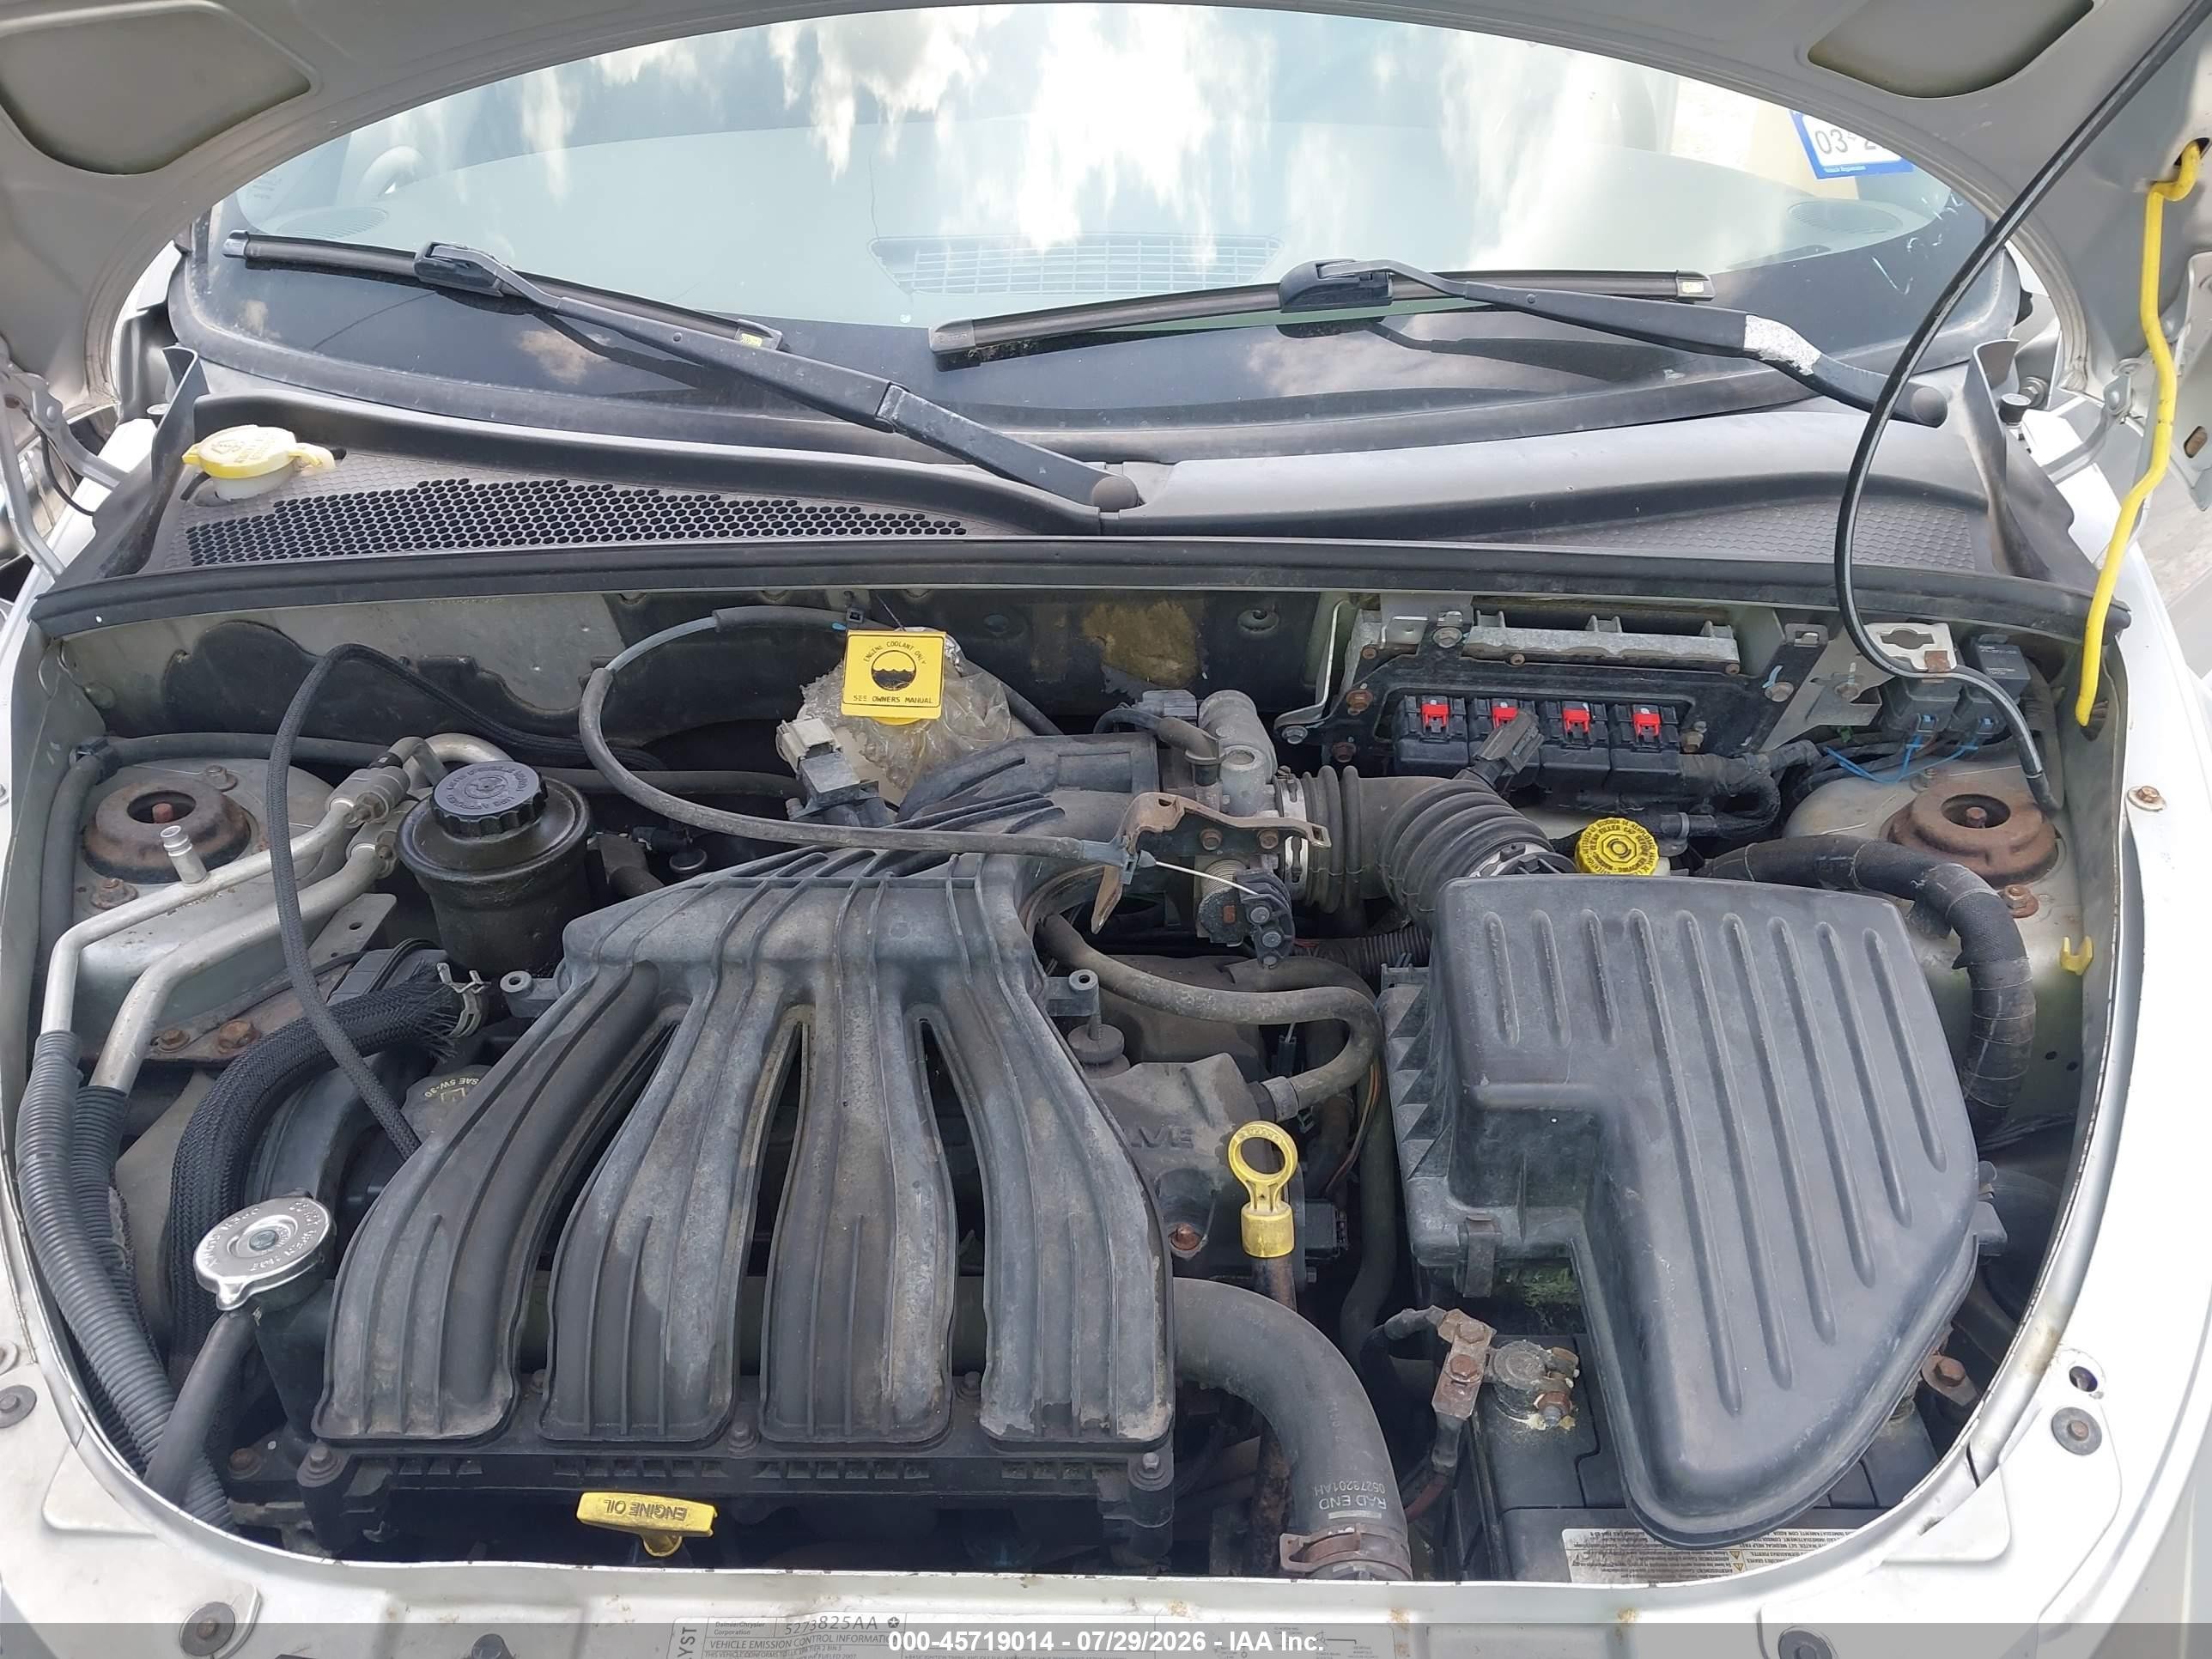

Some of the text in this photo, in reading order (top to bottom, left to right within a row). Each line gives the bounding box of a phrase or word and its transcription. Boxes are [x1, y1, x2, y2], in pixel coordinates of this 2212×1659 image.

[1814, 128, 1849, 155] 03
[863, 641, 927, 665] ENGINE COOLANT ONLY
[424, 1077, 480, 1098] SAE 5W-30
[604, 1498, 688, 1522] ENGINE OIL
[1319, 1494, 1387, 1510] RAD END
[785, 1615, 878, 1635] 5273825AA
[677, 1626, 697, 1659] YST
[709, 1640, 747, 1650] VEHICLE
[749, 1639, 792, 1650] EMISSION
[793, 1633, 834, 1648] CONTROL
